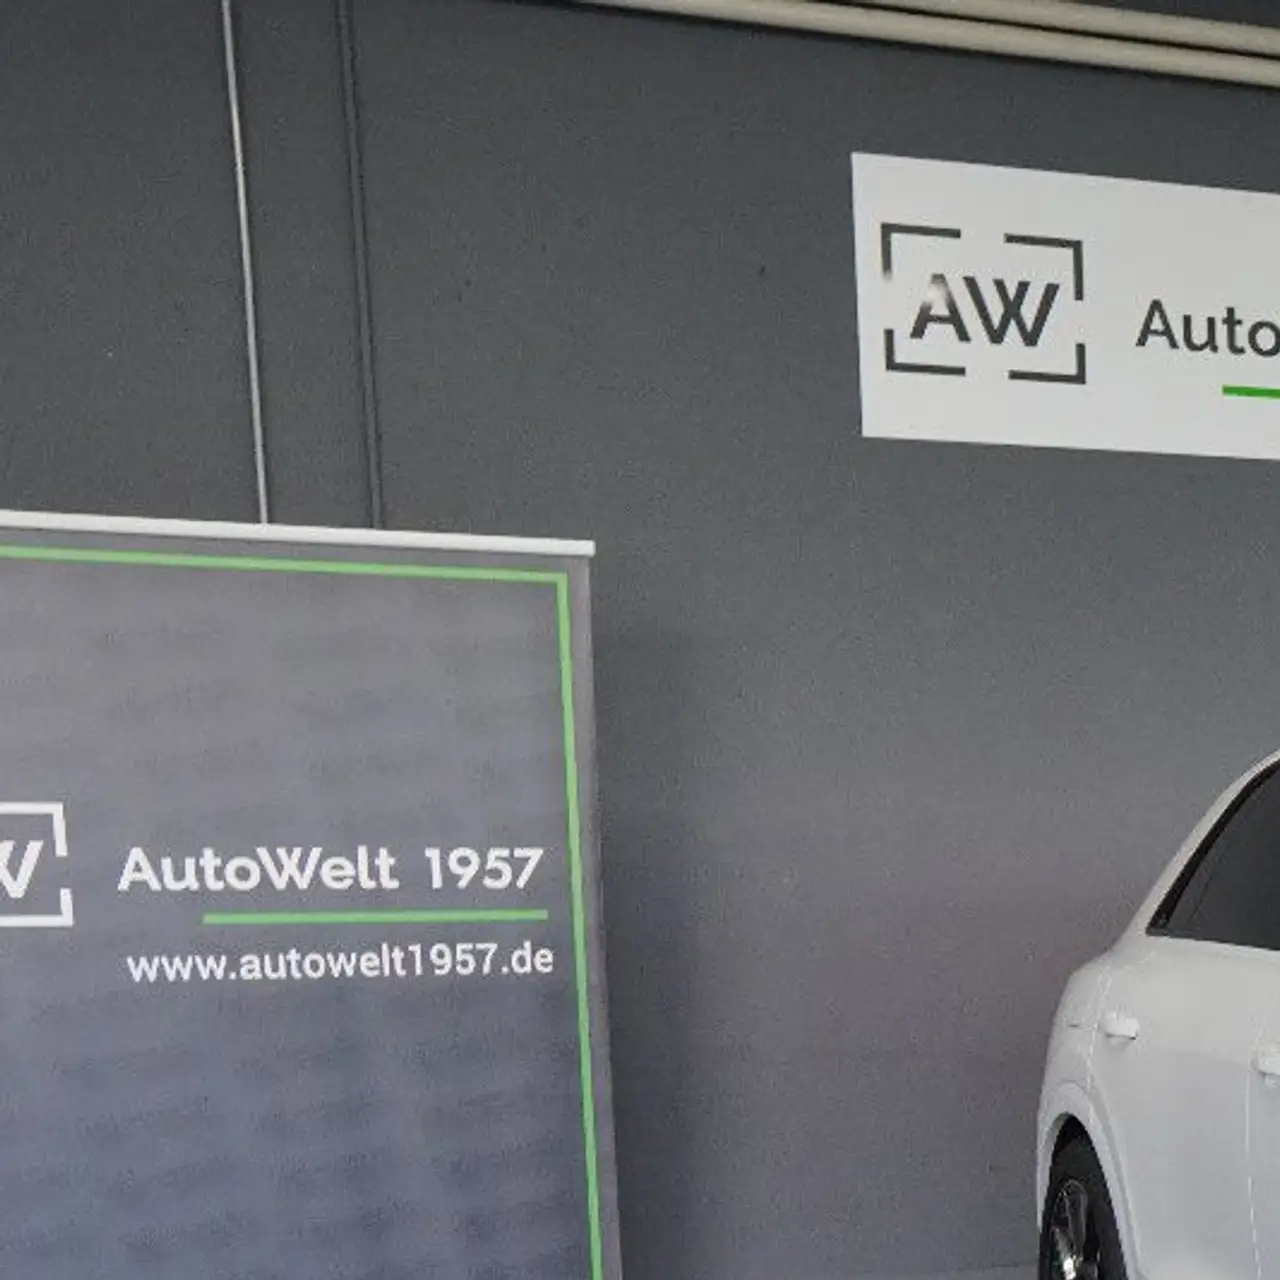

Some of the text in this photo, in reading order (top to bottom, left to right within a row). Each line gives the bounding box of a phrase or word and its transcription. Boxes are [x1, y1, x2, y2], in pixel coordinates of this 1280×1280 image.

[909, 273, 1060, 347] AW
[117, 846, 544, 893] AutoWelt 1957
[126, 941, 554, 983] www.autowelt1957.de
